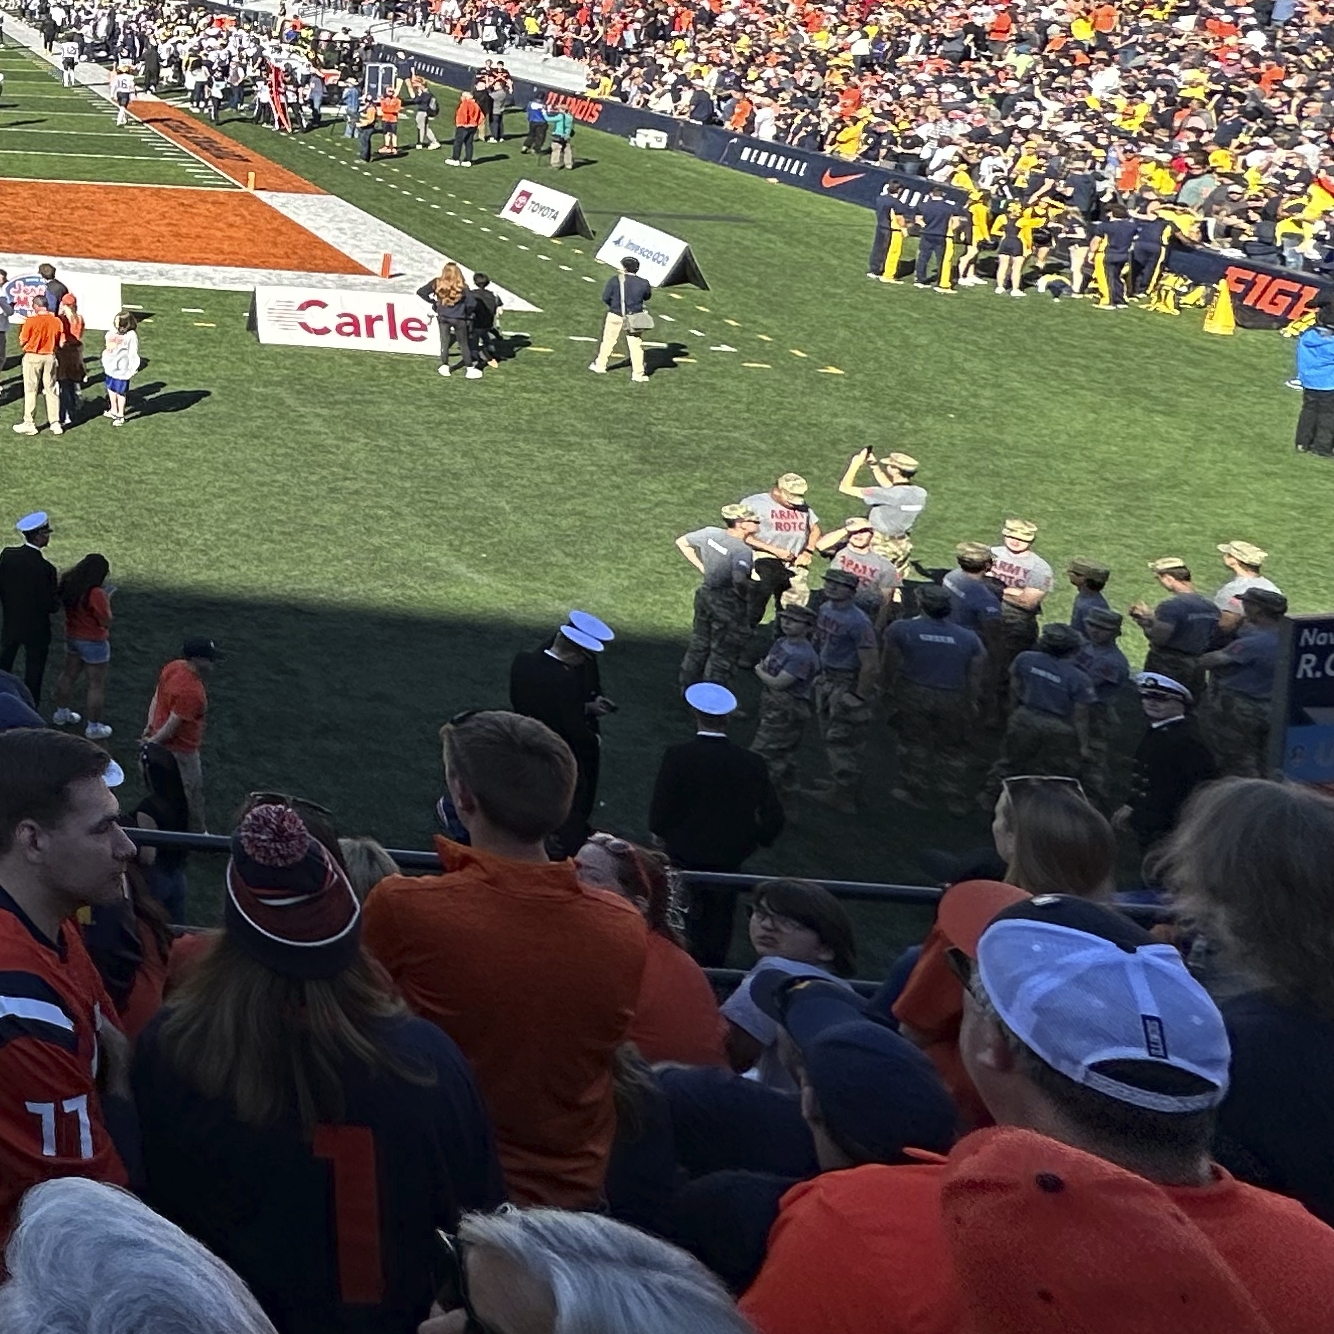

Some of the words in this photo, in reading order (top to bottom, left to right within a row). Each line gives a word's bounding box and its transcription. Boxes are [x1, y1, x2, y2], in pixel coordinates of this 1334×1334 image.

[740, 146, 808, 177] MEMORIAL
[527, 200, 561, 222] TOYOTA
[296, 299, 429, 343] Carle
[774, 521, 807, 533] ROTC
[312, 1122, 387, 1304] 1
